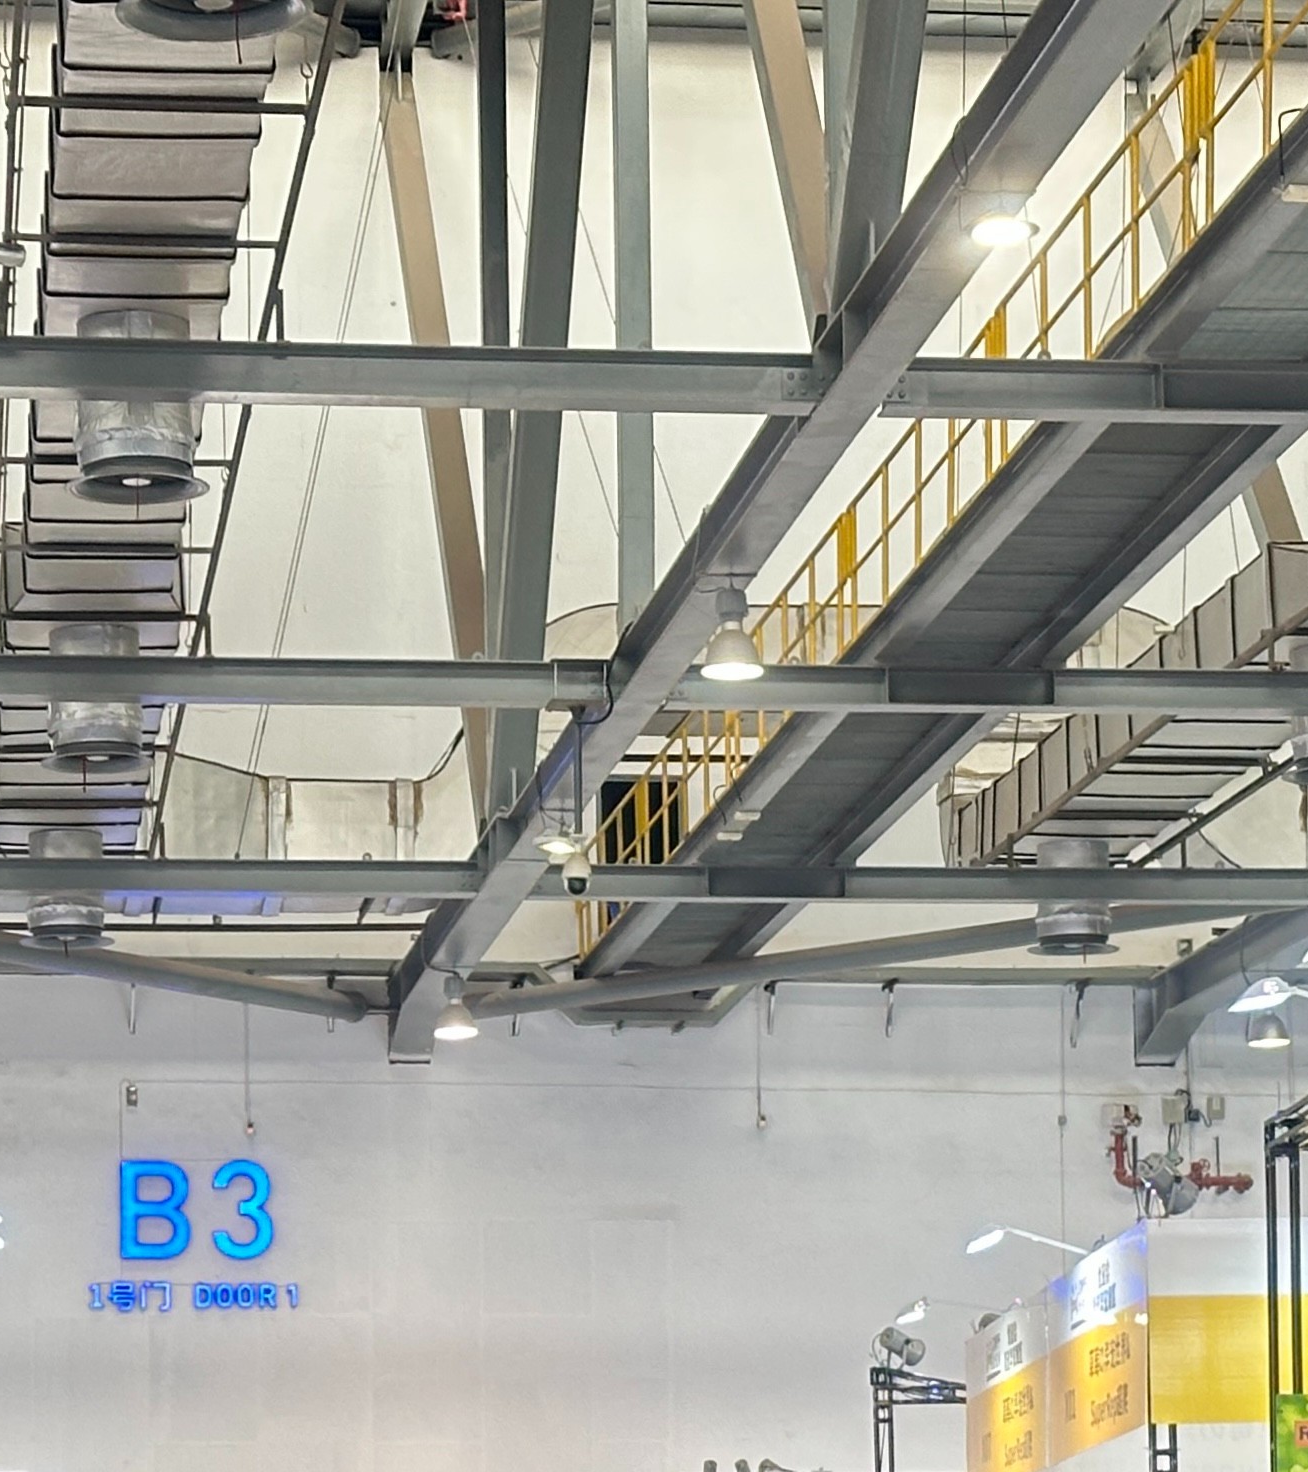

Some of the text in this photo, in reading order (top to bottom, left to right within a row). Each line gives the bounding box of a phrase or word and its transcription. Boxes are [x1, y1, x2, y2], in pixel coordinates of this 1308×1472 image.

[120, 1159, 274, 1260] B3
[89, 1281, 171, 1312] 1号门
[194, 1283, 277, 1309] DOOR
